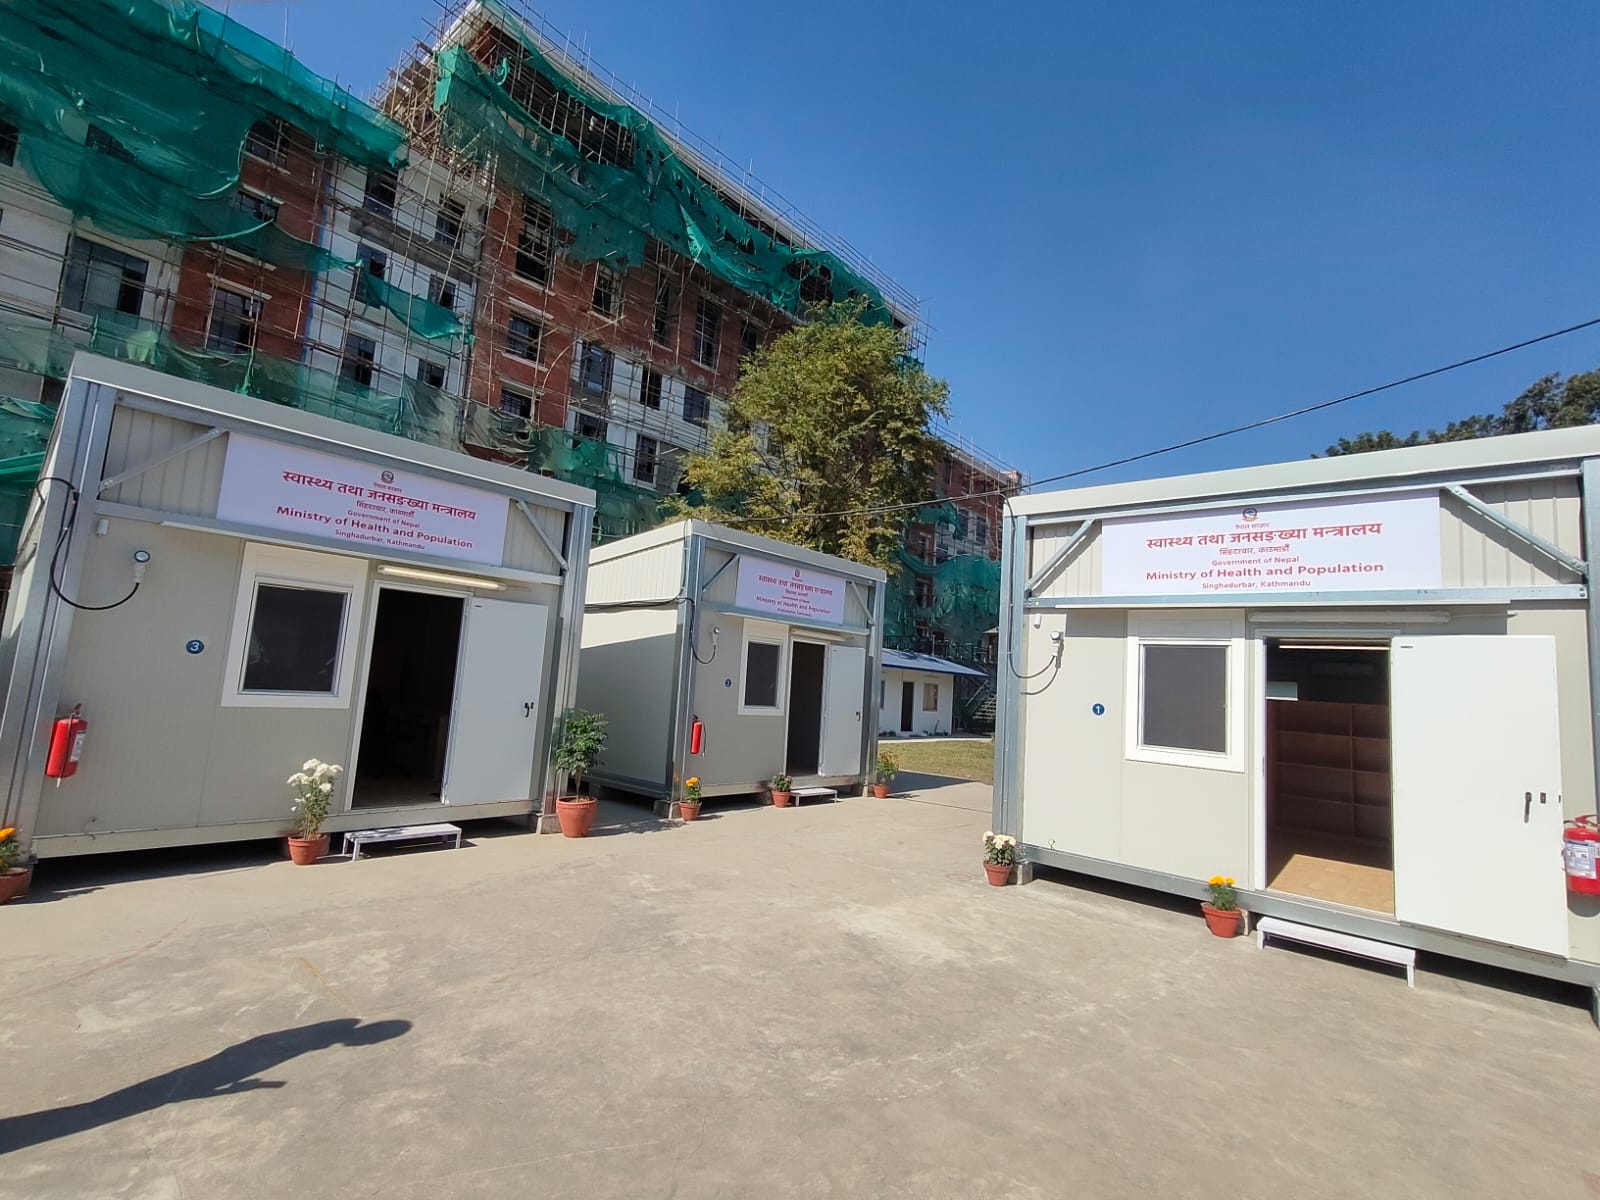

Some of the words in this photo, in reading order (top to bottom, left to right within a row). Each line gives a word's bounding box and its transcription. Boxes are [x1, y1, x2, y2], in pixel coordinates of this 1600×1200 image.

[283, 471, 334, 490] स्वास्थ्य
[337, 482, 364, 497] तथा
[432, 503, 477, 520] मन्त्रालय
[276, 506, 332, 524] Ministry
[335, 518, 348, 526] of
[351, 519, 389, 533] Health
[393, 528, 414, 538] and
[417, 531, 473, 549] Population
[347, 509, 391, 523] Government
[401, 520, 421, 529] Nepal
[335, 529, 385, 544] Singhadurbar,
[386, 538, 425, 550] Kathmandu
[1146, 535, 1194, 548] स्वास्थ्य
[1197, 533, 1225, 546] तथा
[1312, 523, 1383, 538] मन्त्रालय
[1146, 571, 1197, 580] Ministry
[1200, 569, 1215, 578] of
[1217, 567, 1262, 577] Health
[1266, 566, 1293, 576] and
[1298, 562, 1384, 576] Population
[1211, 558, 1261, 567] Government
[1274, 555, 1300, 564] Nepal
[1202, 581, 1258, 590] Singhadurbar,
[1260, 579, 1311, 588] Kathmandu
